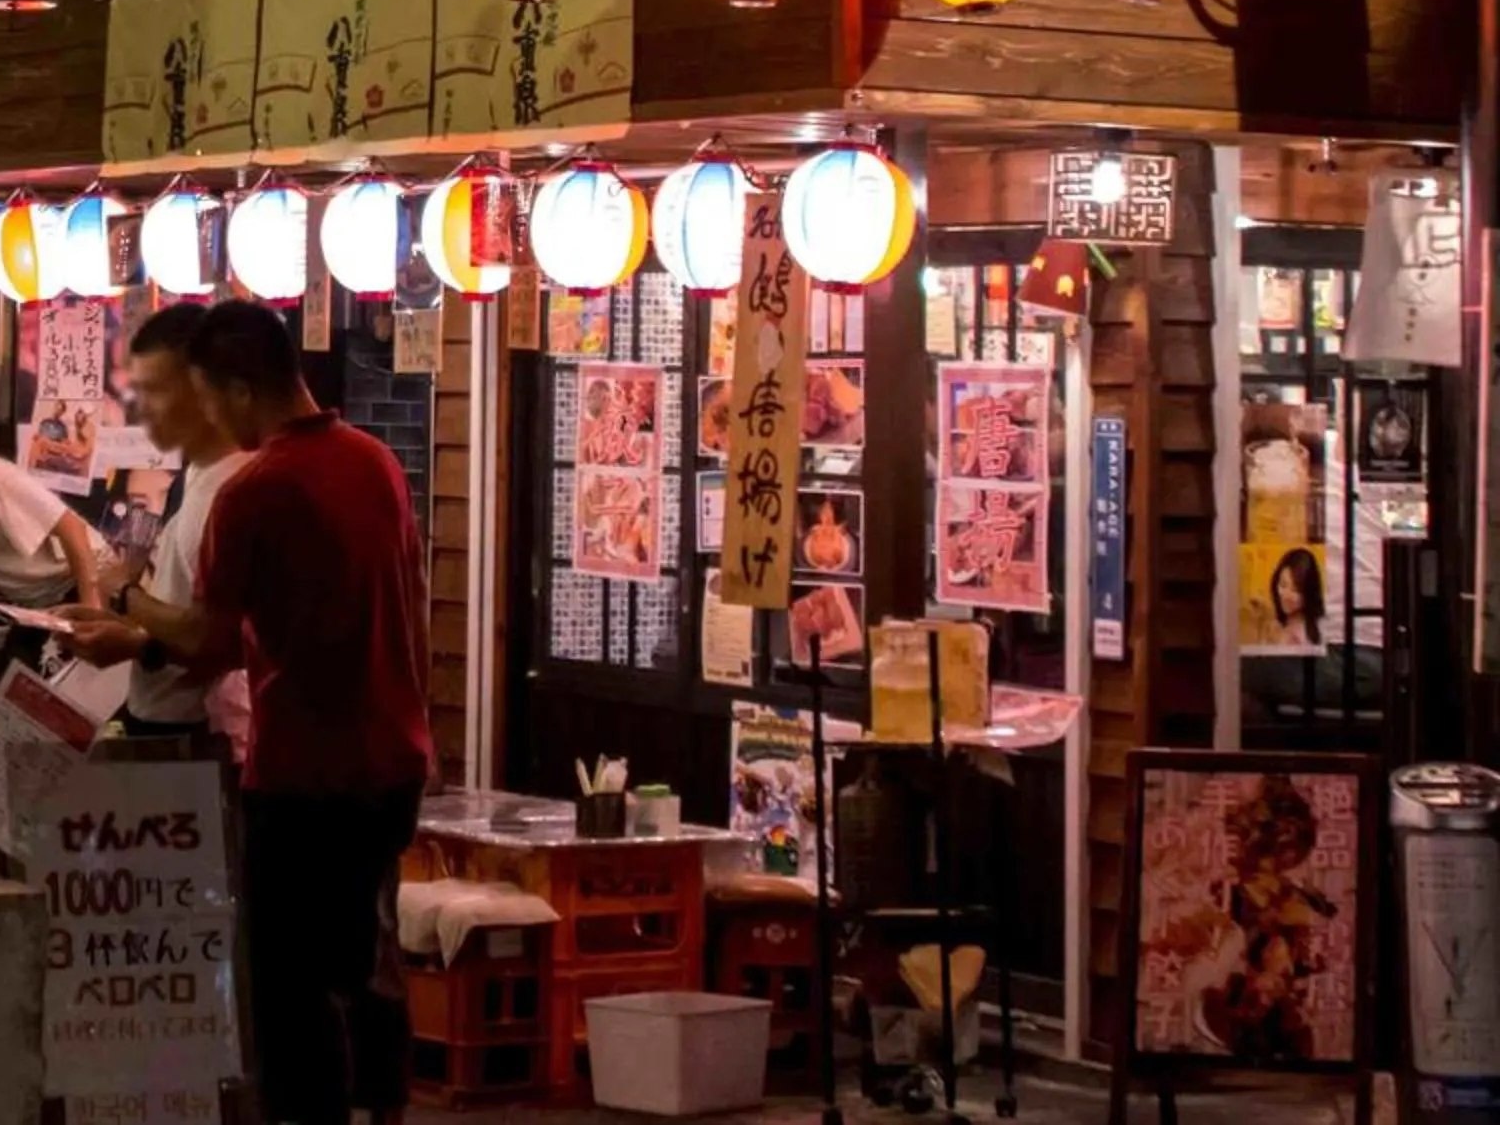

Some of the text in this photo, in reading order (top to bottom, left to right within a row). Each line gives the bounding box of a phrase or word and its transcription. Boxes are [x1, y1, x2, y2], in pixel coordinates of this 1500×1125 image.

[59, 811, 202, 852] せんべろ
[45, 868, 195, 918] 1000円で
[47, 927, 226, 969] 3杯飲んで
[75, 972, 198, 1006] ベロベロ
